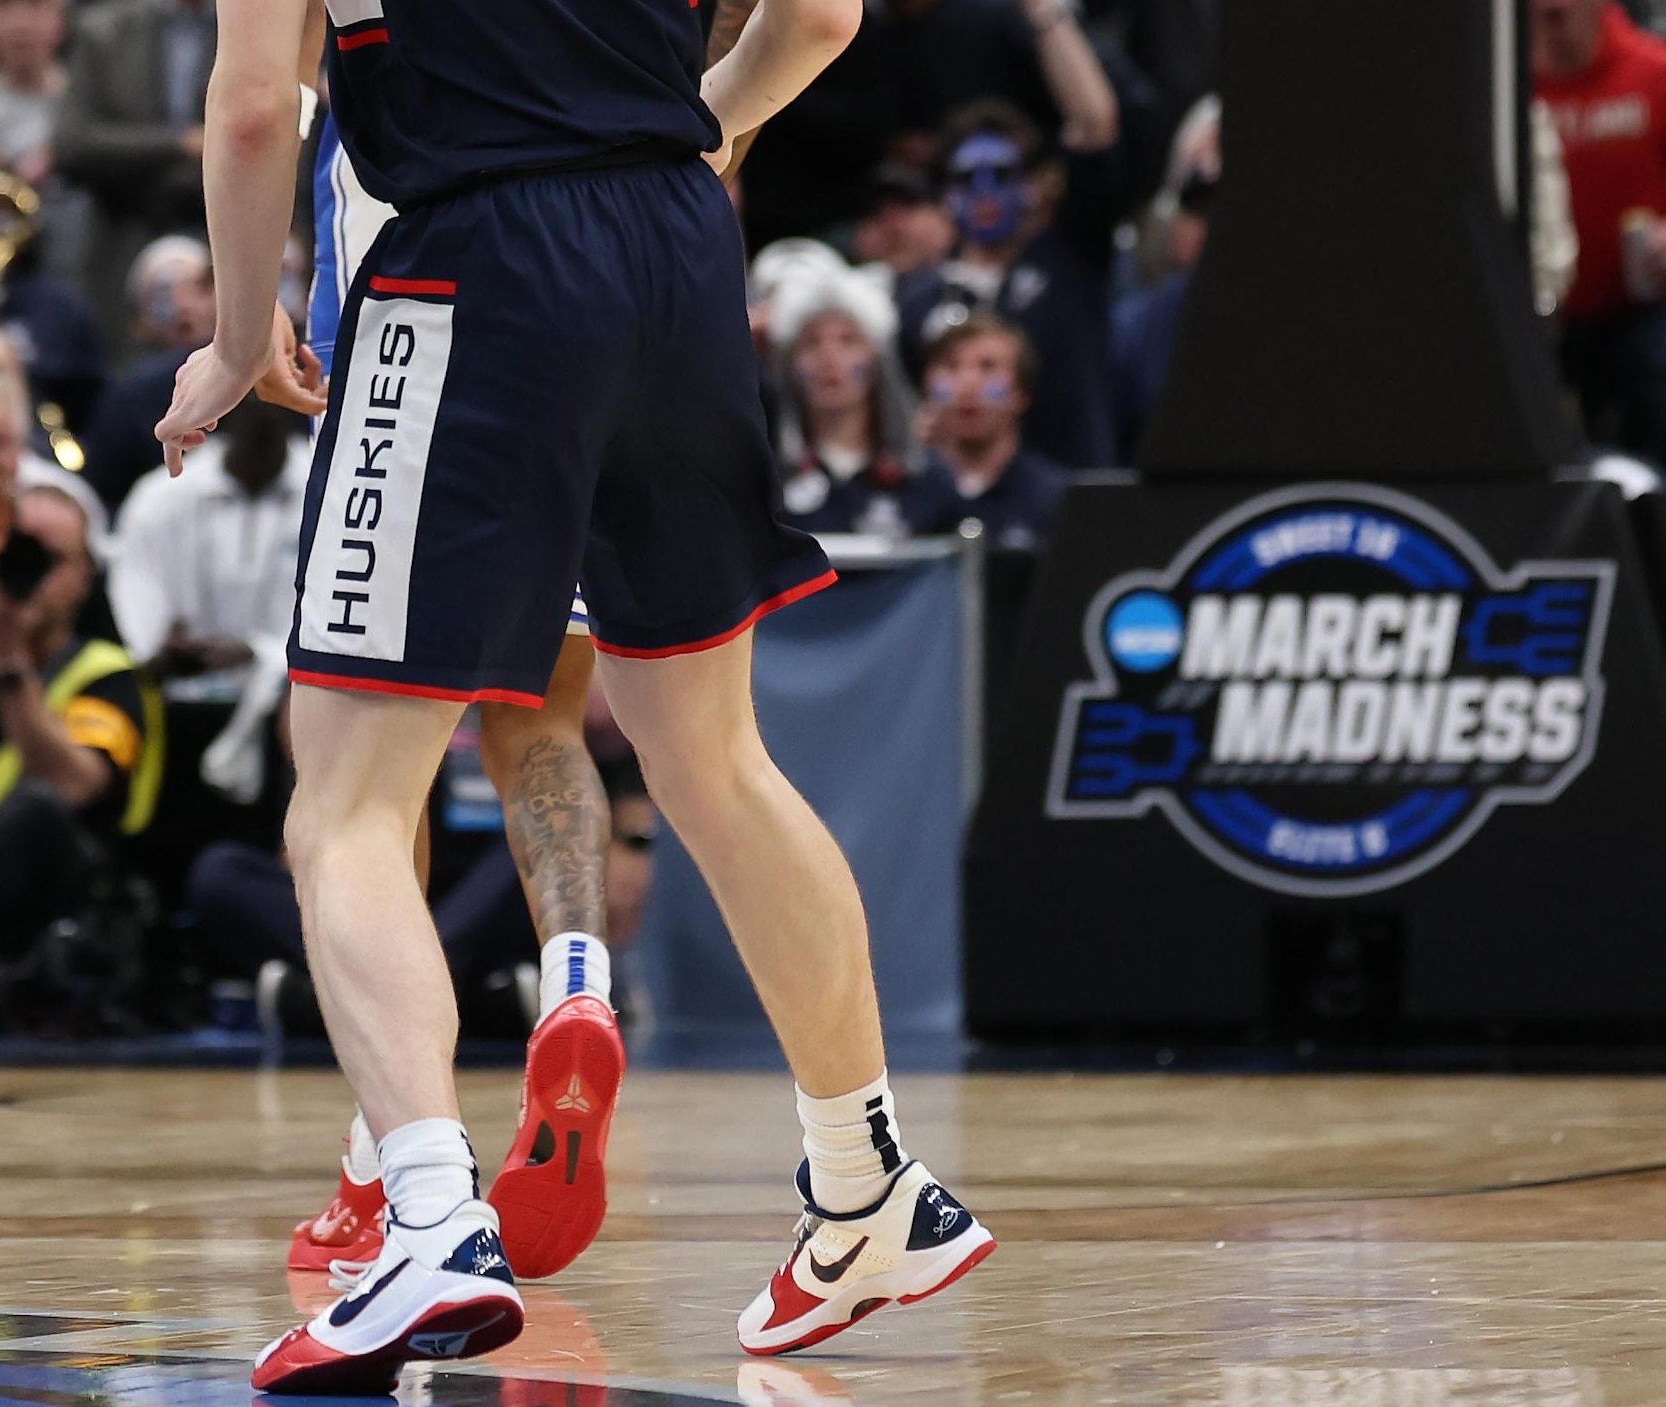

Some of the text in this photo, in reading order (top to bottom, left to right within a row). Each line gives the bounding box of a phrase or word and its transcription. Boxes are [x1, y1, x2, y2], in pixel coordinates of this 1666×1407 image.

[326, 322, 416, 635] HUSKIES
[1178, 593, 1463, 681] MARCH
[1209, 676, 1587, 767] MADNESS
